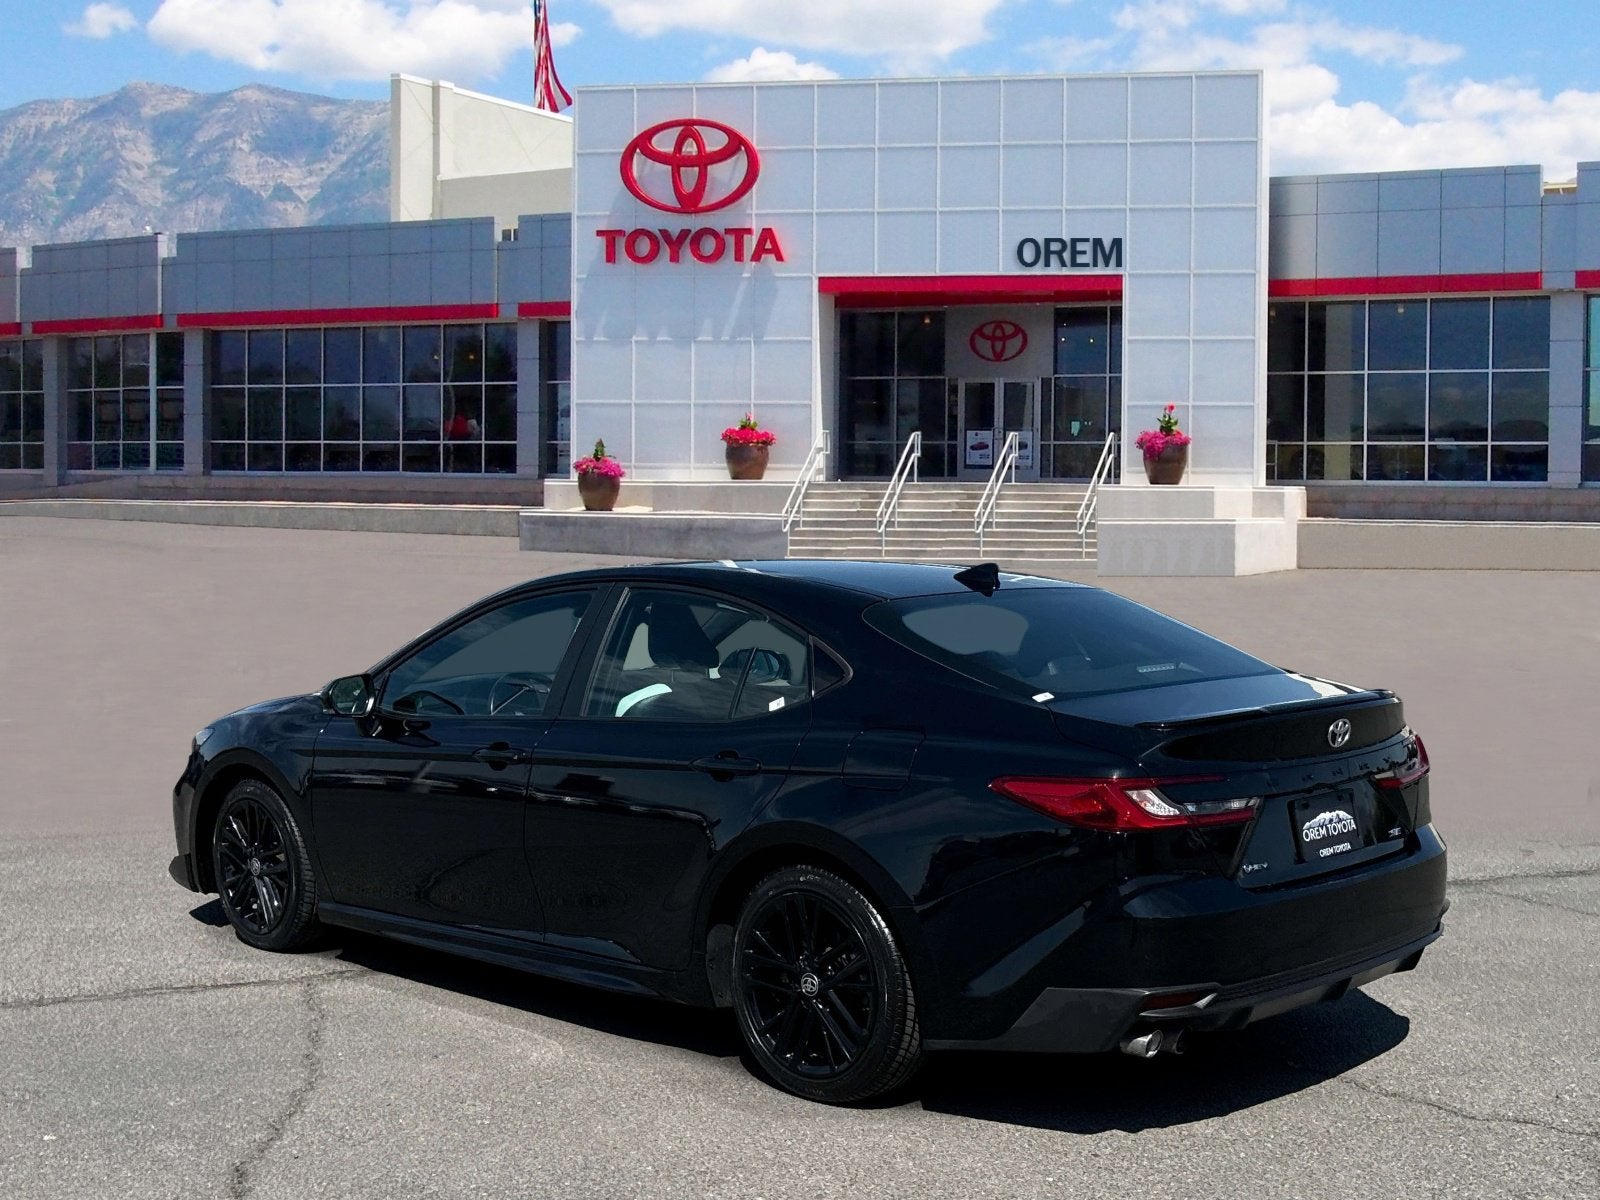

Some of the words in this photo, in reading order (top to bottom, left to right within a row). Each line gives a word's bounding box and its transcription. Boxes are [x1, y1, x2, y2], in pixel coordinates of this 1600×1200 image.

[596, 227, 785, 265] TOYOTA
[1016, 237, 1123, 268] OREM
[1303, 825, 1328, 842] OREM
[1327, 818, 1356, 836] TOYOTA
[1319, 847, 1334, 857] OREM
[1333, 842, 1352, 854] TOYOTA
